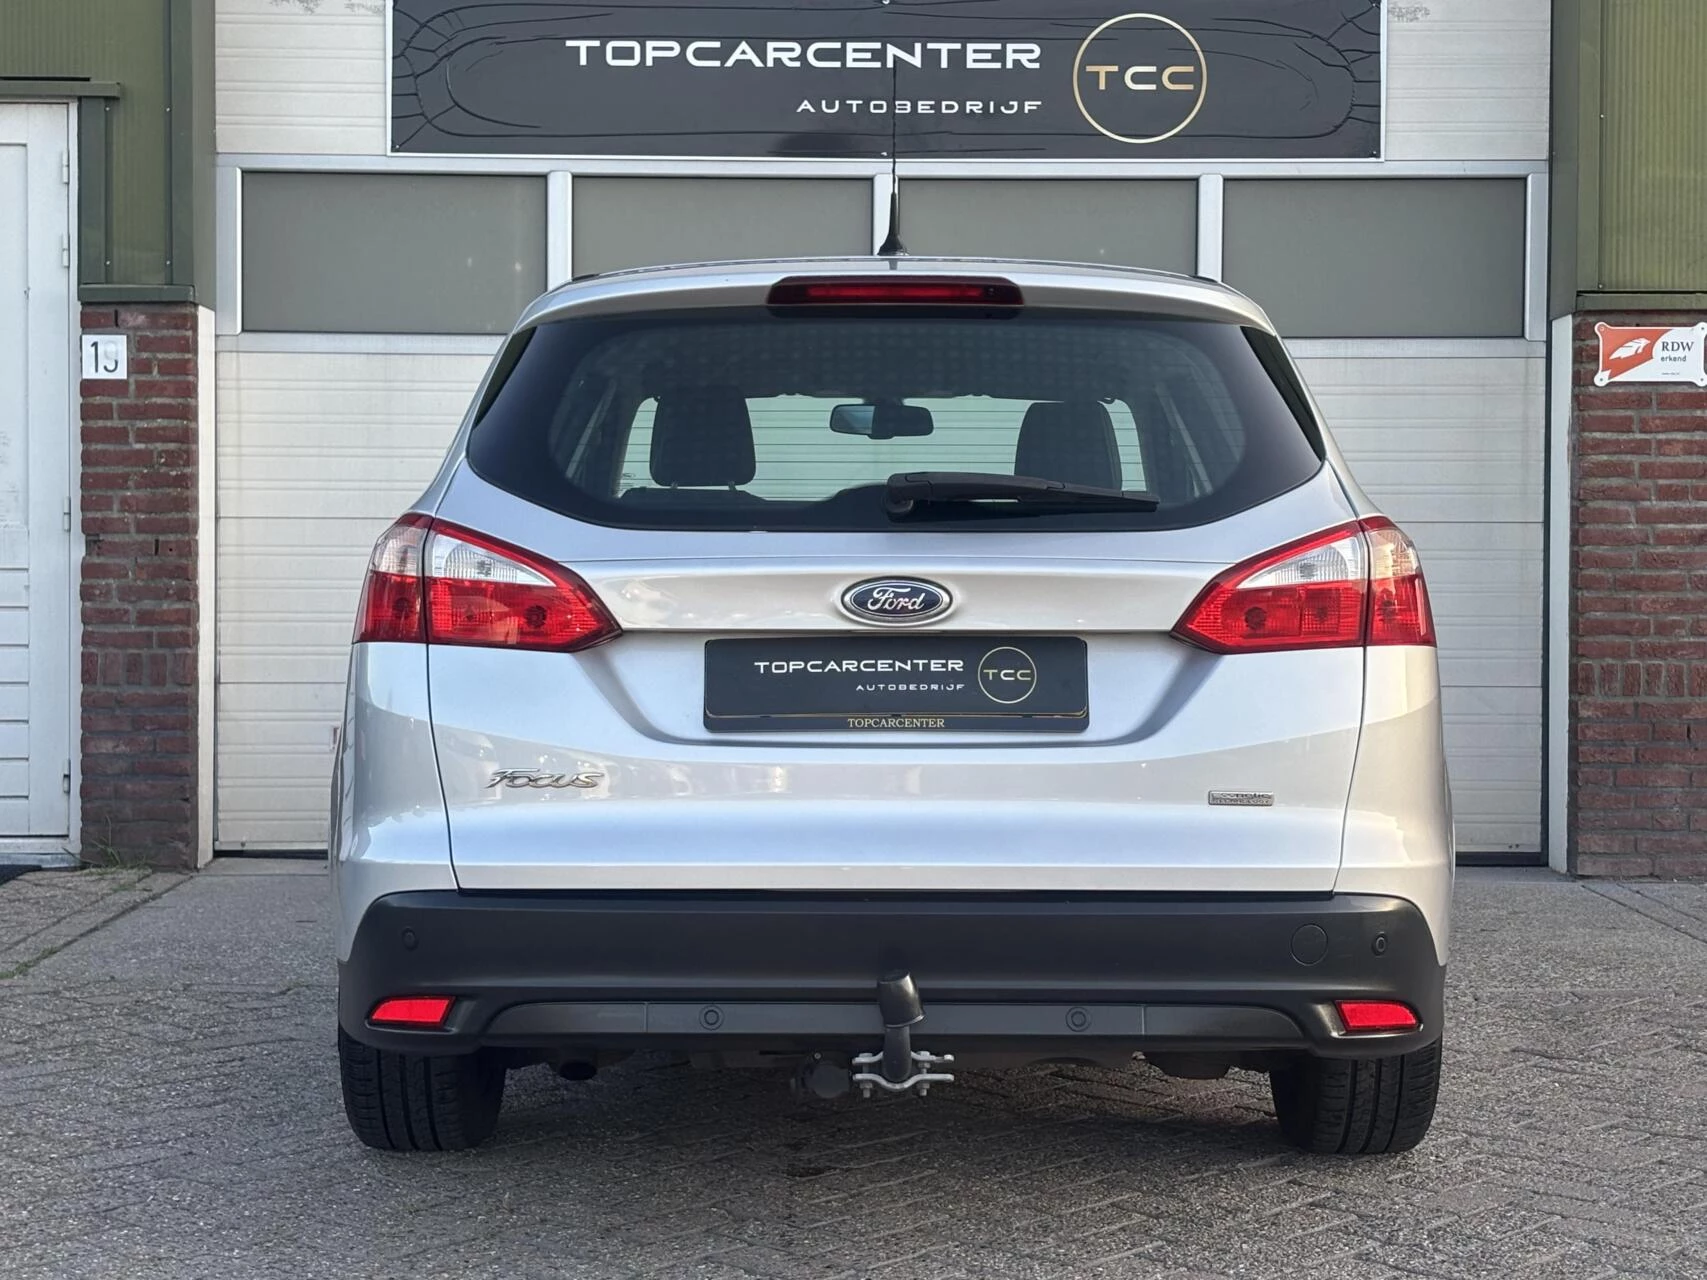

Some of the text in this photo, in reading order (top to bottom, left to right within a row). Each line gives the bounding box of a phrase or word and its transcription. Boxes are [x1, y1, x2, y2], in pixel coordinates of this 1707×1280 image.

[565, 39, 1042, 69] TOPCARCENTER
[1085, 64, 1196, 91] TCC
[796, 99, 1043, 115] AUTOBEDRIJF
[1661, 341, 1694, 351] RDW
[867, 586, 926, 612] Ford
[754, 660, 964, 674] TOPCARCENTER
[983, 669, 1031, 681] TCC
[856, 683, 965, 692] AUTOBEDRIJF
[847, 718, 945, 728] TOPCARCENTER
